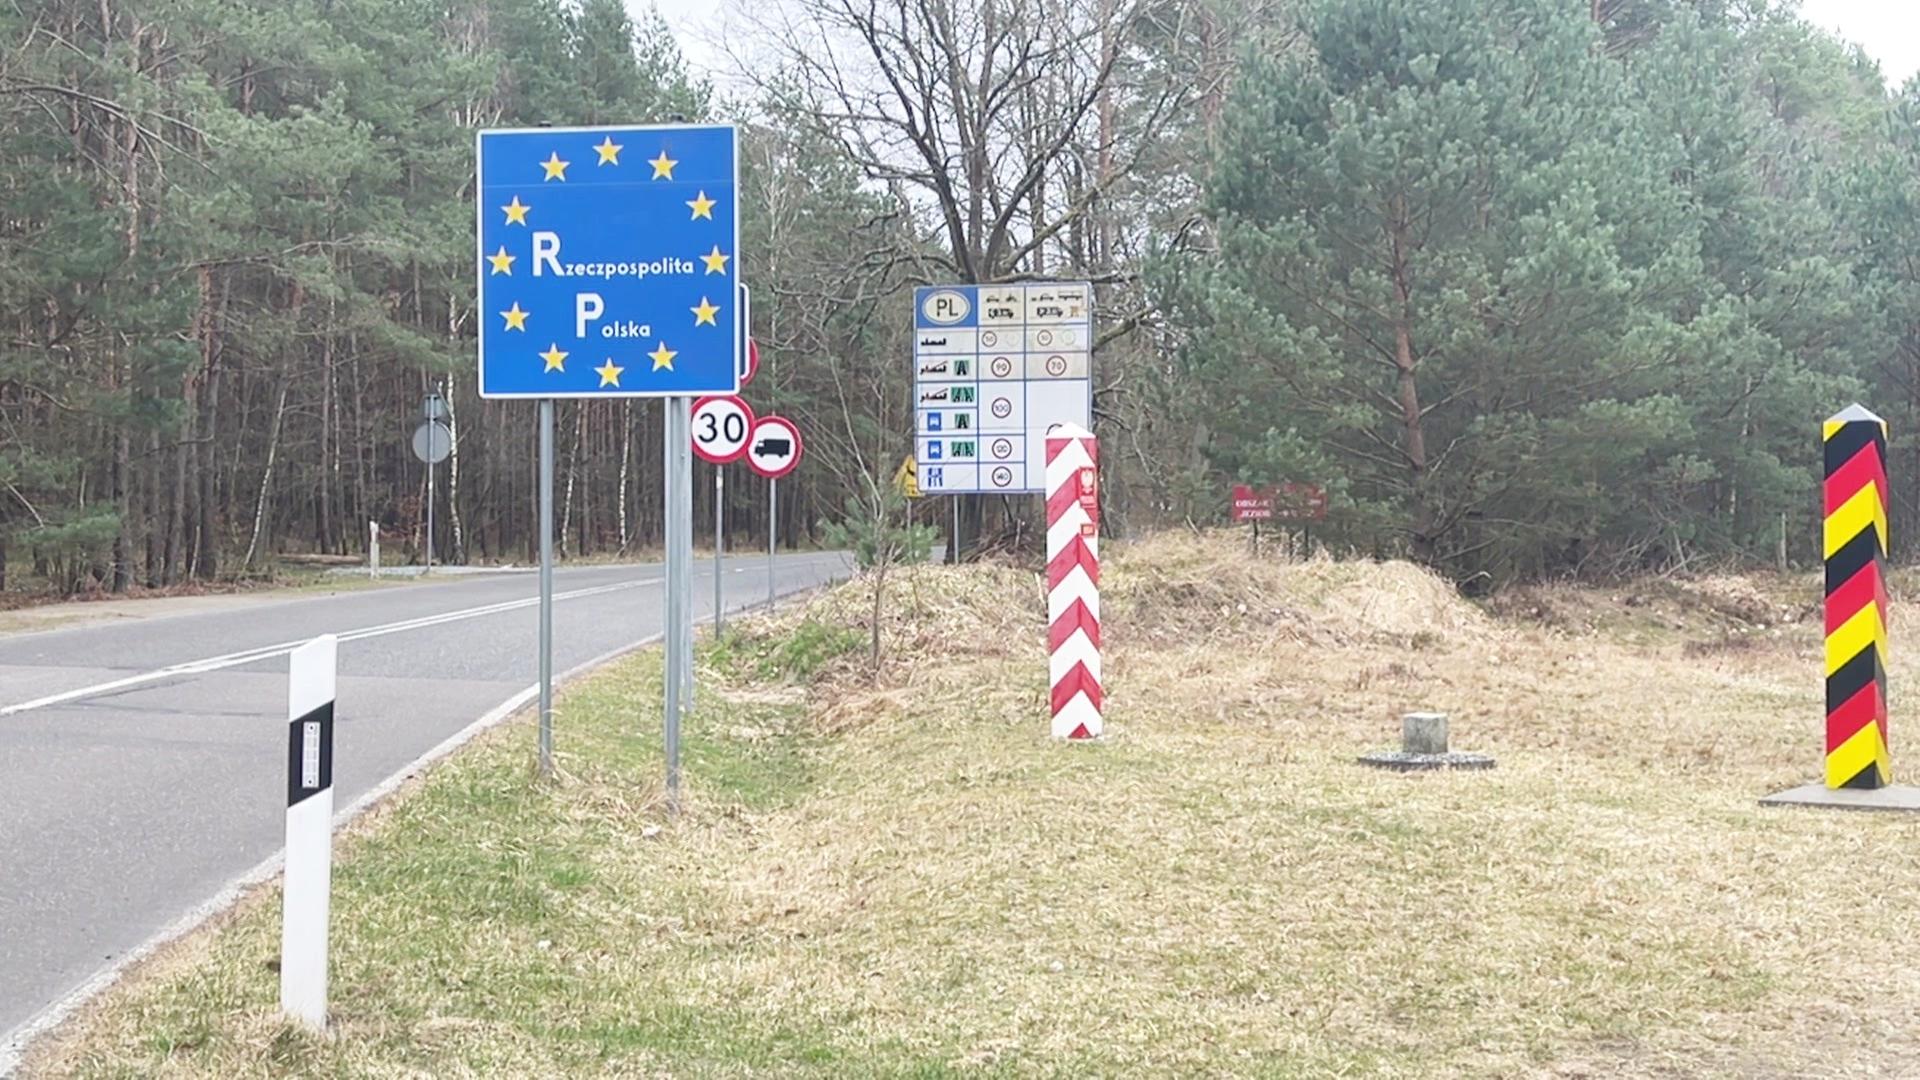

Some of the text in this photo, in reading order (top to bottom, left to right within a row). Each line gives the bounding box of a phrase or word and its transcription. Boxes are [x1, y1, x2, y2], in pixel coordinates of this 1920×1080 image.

[532, 231, 694, 280] Rzeczpospolita
[576, 293, 651, 338] Polska
[936, 299, 959, 317] PL
[996, 363, 1007, 372] 90
[1051, 361, 1062, 370] 70
[698, 412, 744, 443] 30
